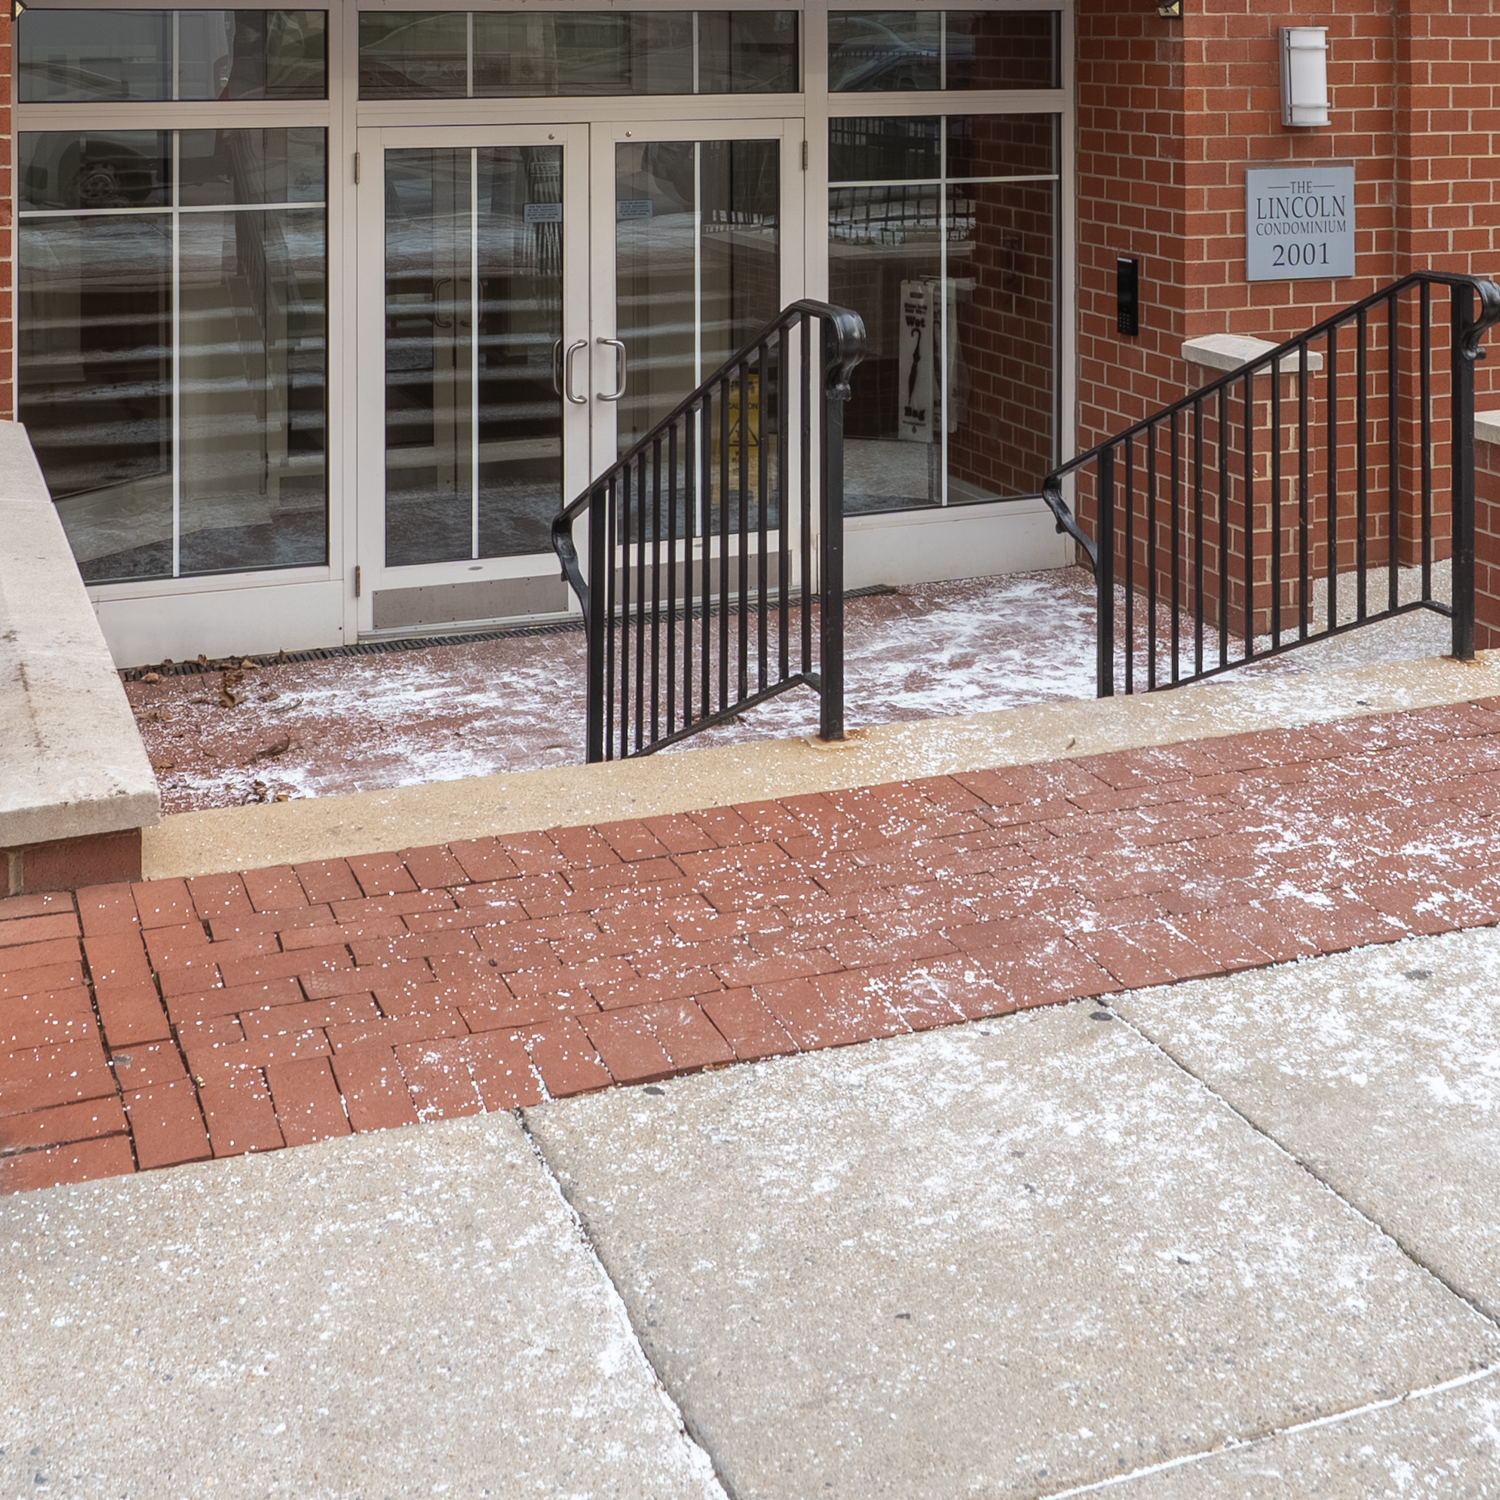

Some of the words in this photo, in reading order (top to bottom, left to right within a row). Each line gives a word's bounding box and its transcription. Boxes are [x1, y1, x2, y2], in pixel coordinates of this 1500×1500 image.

[1290, 180, 1313, 194] THE
[1256, 195, 1346, 220] LINCOLN
[1255, 219, 1347, 236] CONDOMINIUM
[1272, 242, 1330, 267] 2001
